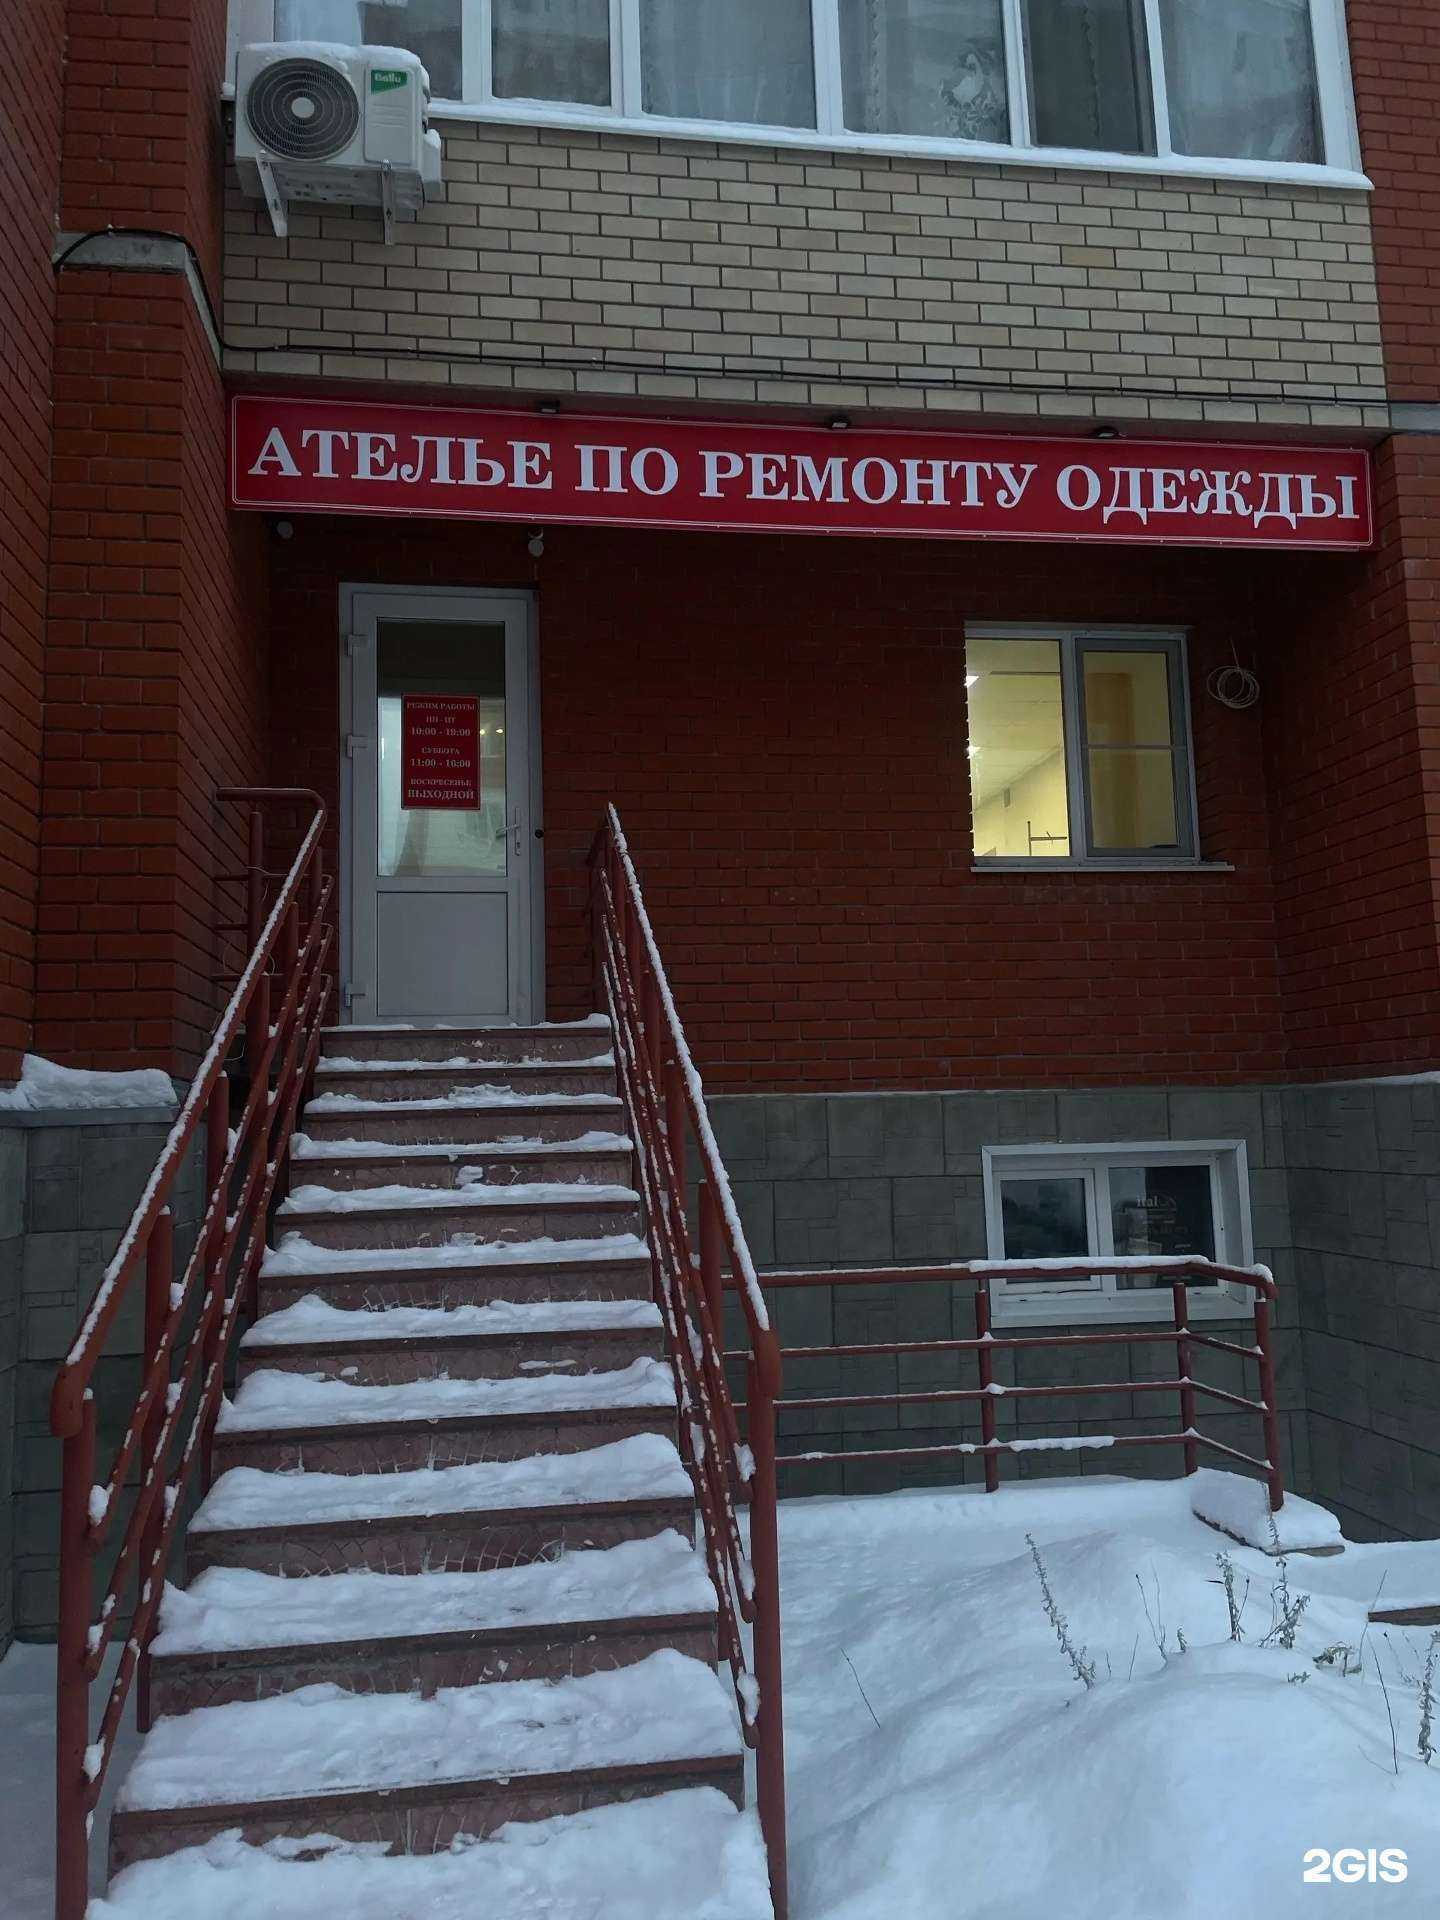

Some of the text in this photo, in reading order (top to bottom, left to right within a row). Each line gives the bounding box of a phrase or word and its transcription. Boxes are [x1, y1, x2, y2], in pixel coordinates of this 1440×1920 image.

[247, 426, 1360, 530] АТЕЛЬЕ ПО РЕМОНТУ ОДЕЖДЫ
[440, 703, 475, 711] РАБОТЫ
[411, 727, 437, 736] 10:00
[421, 746, 460, 755] СУББОТА
[410, 758, 436, 767] 11:00
[408, 789, 474, 800] ВЫХОДНОЙ
